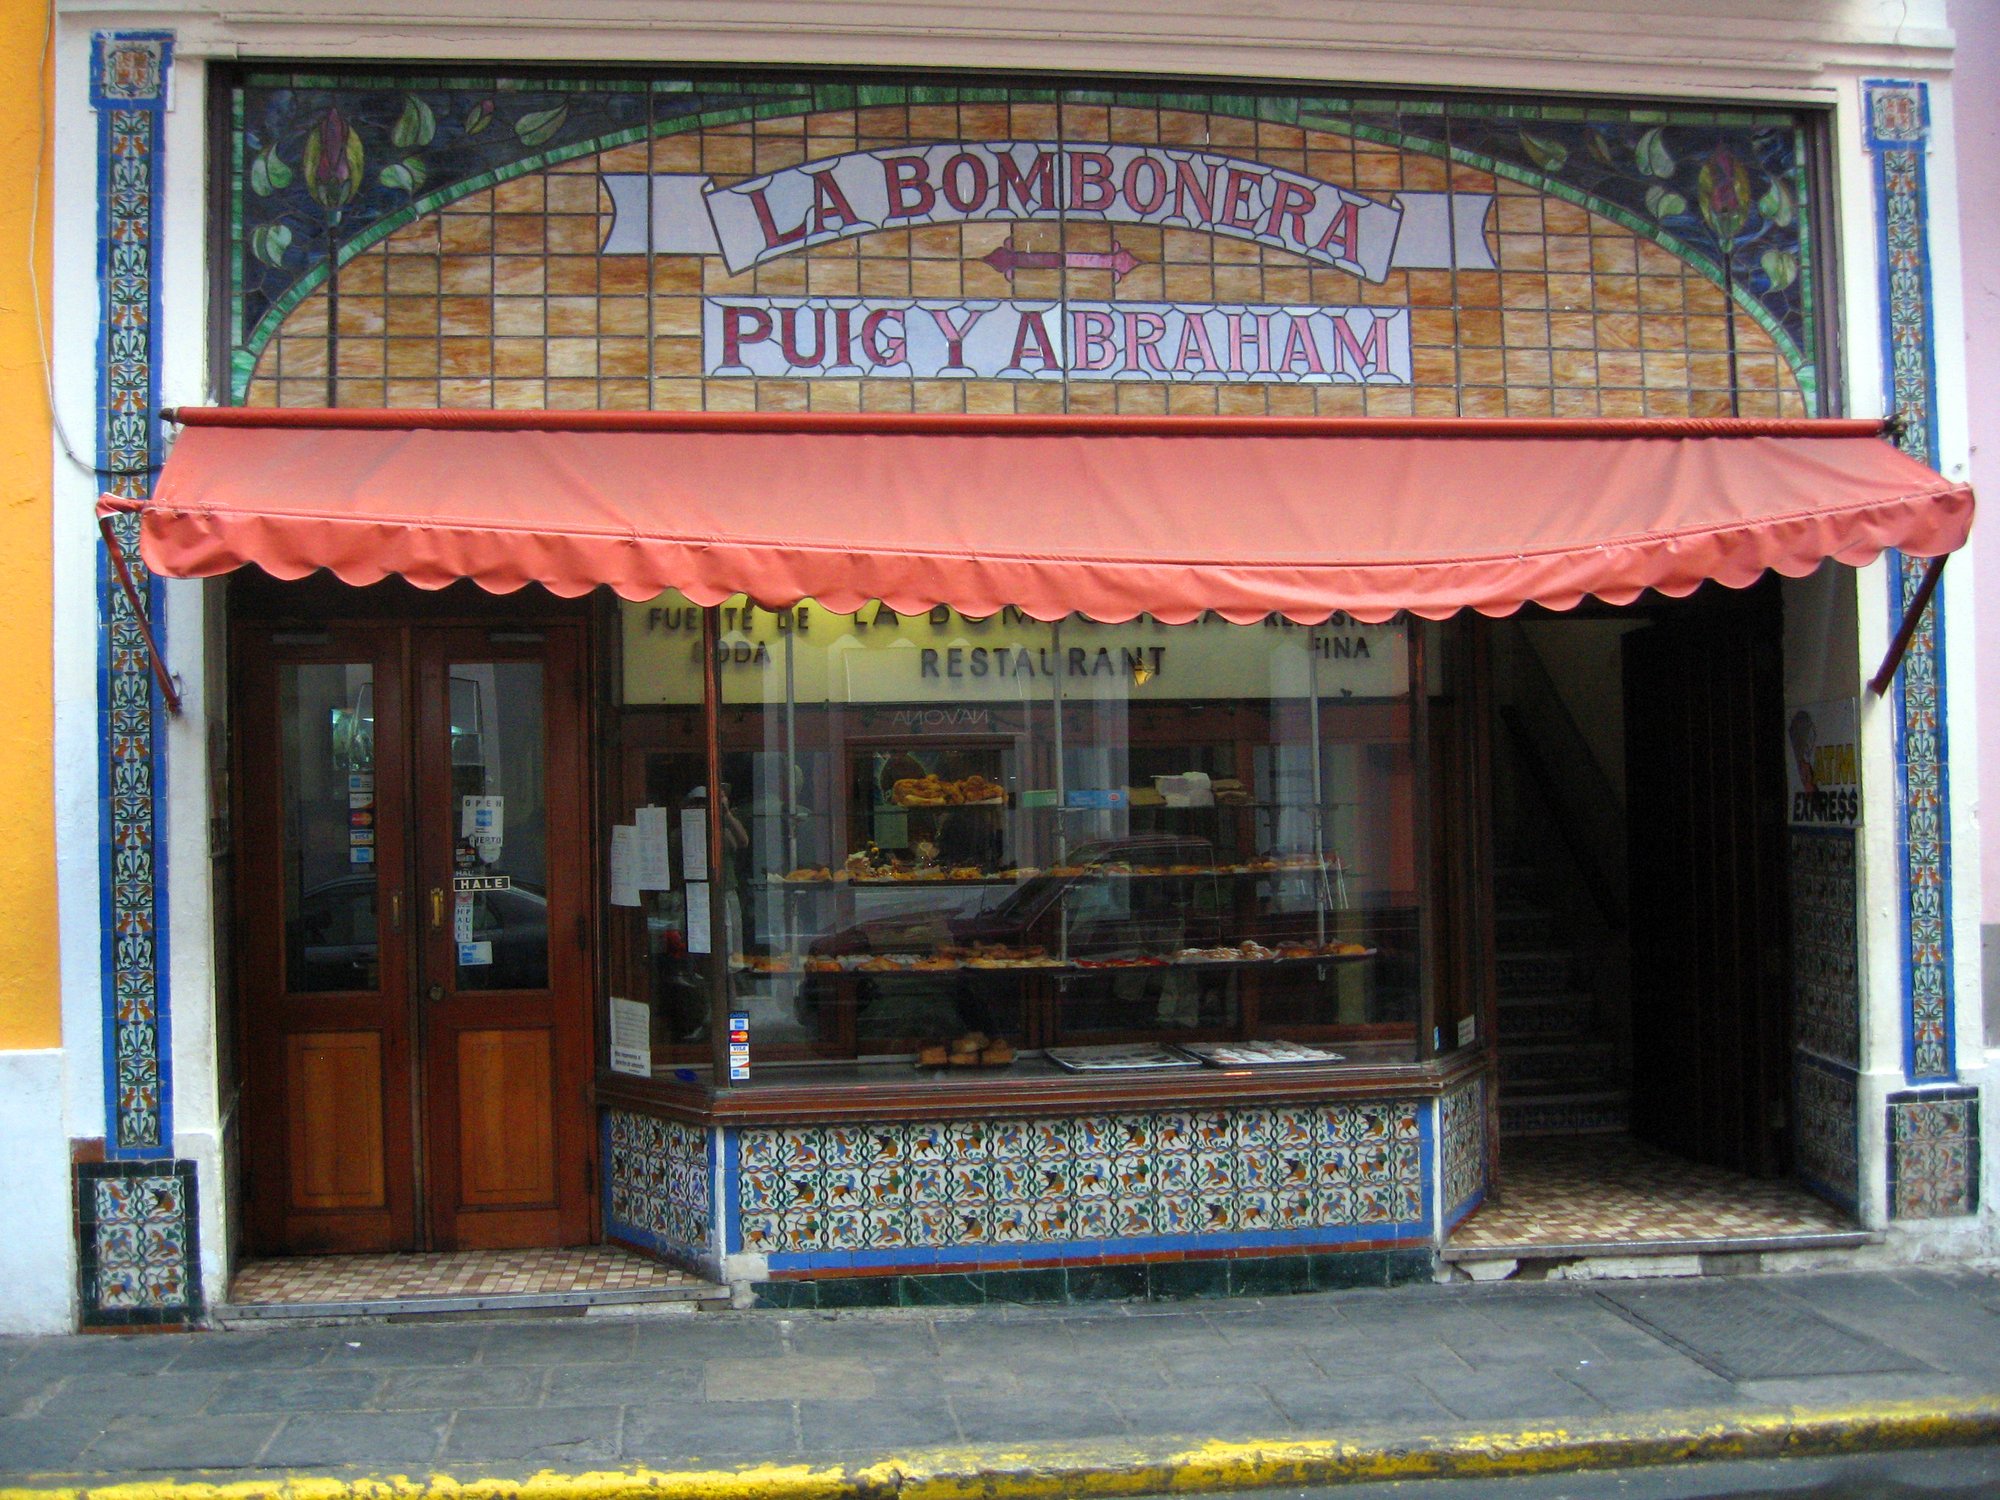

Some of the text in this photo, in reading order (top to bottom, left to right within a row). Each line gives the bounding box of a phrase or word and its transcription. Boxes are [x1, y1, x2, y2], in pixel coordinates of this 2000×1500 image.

[749, 150, 1361, 270] LA BOMBONERA
[722, 304, 1391, 376] PUIG Y ABRAHAM
[649, 607, 809, 630] FUETE DE
[1813, 743, 1857, 786] ATM
[465, 799, 502, 807] OPEN
[461, 878, 503, 889] HALE
